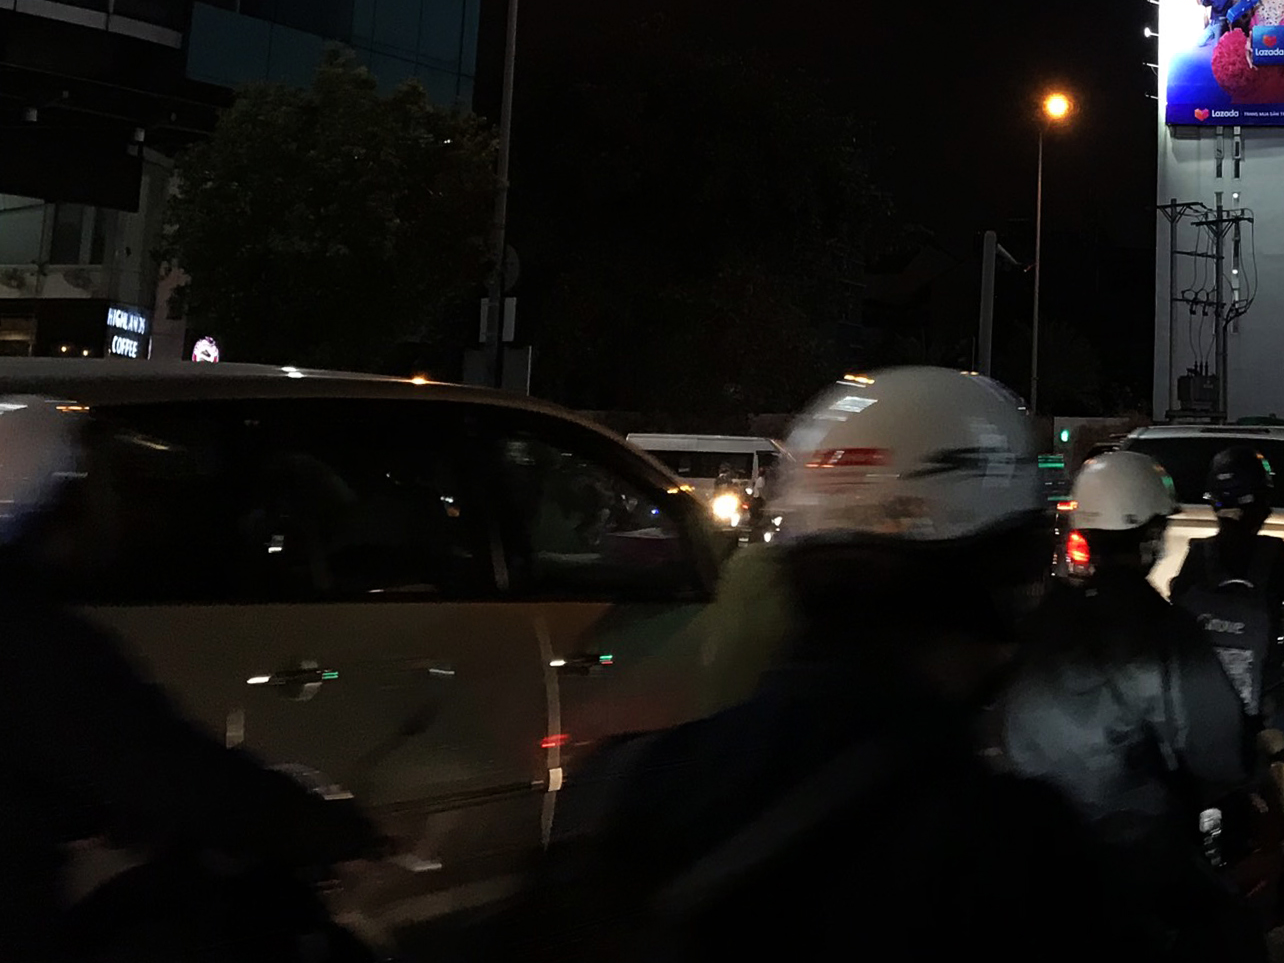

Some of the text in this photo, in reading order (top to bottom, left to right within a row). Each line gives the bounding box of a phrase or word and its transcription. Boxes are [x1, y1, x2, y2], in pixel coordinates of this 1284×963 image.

[1255, 48, 1284, 57] Lazada
[1211, 109, 1239, 118] Lazada
[112, 335, 139, 359] COFFEE
